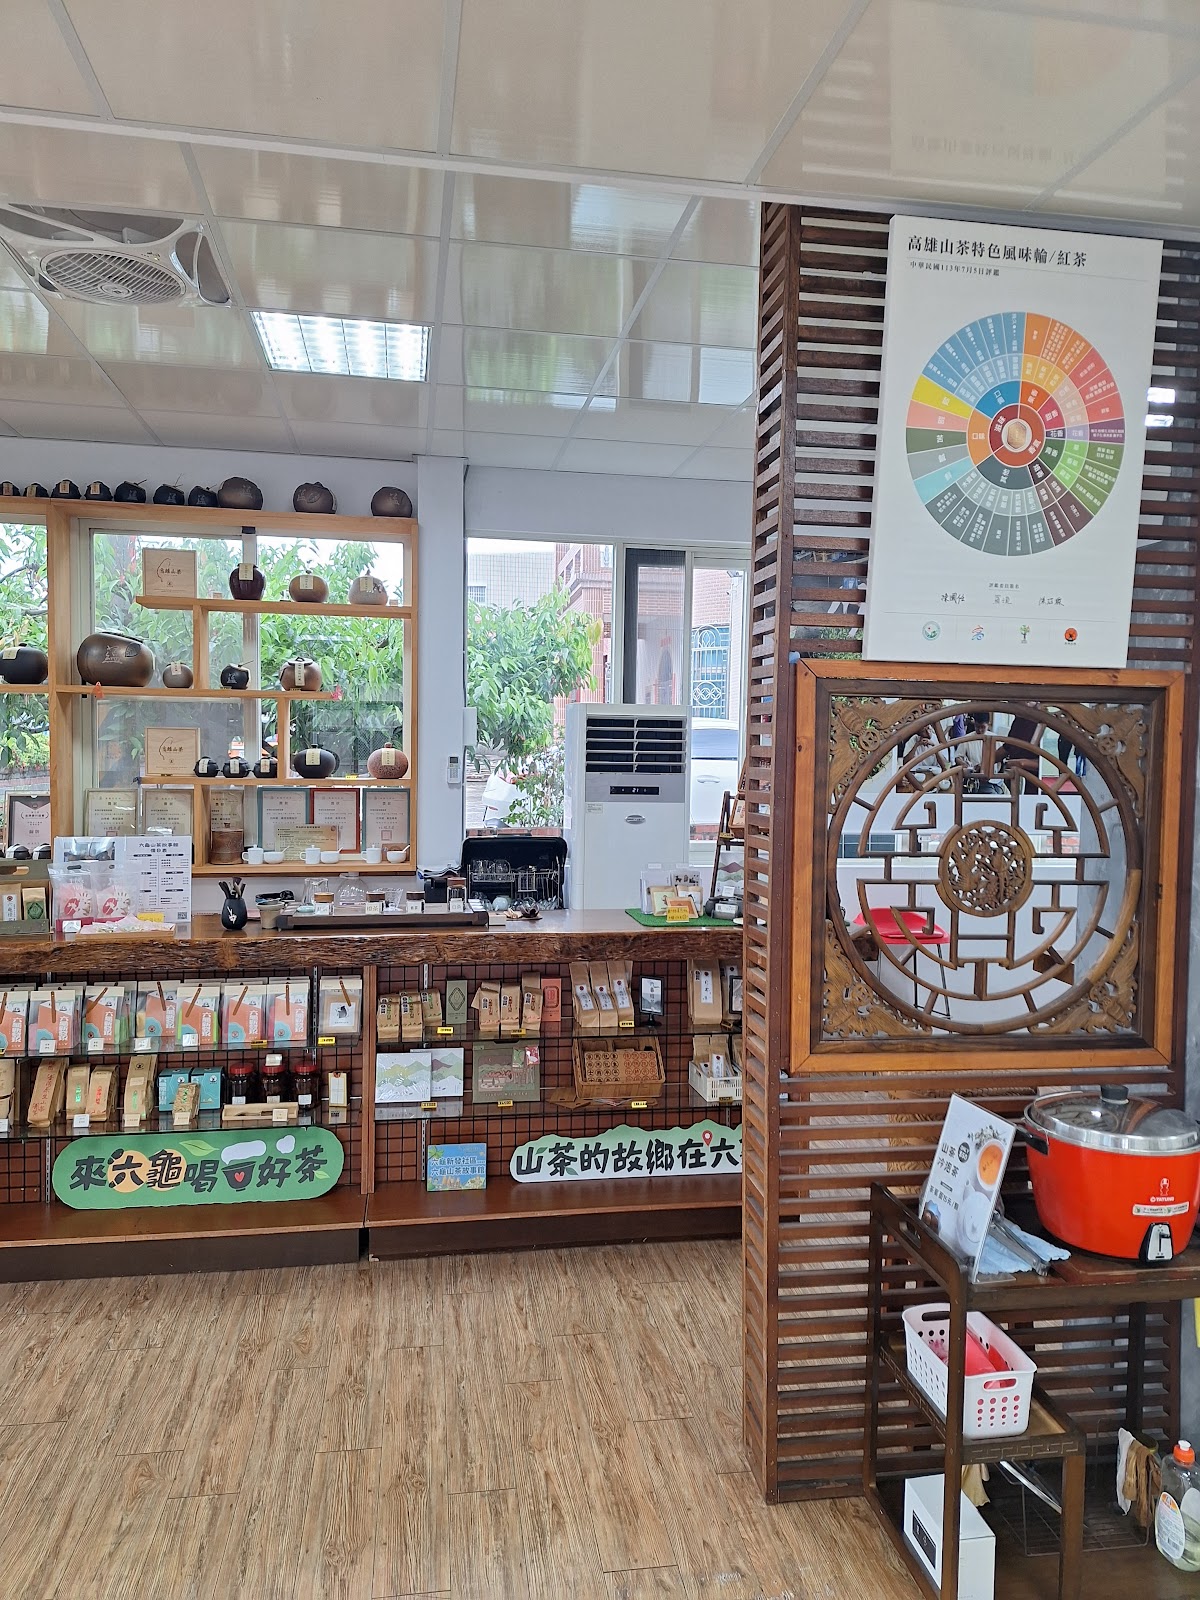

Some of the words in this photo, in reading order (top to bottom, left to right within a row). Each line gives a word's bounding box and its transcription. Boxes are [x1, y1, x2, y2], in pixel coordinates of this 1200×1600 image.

[908, 235, 1087, 268] 高雄山茶特色風味輪/紅茶
[515, 1134, 742, 1178] 山茶的故鄉在六
[941, 1142, 957, 1159] 山茶
[937, 1156, 960, 1178] 冷泡茶
